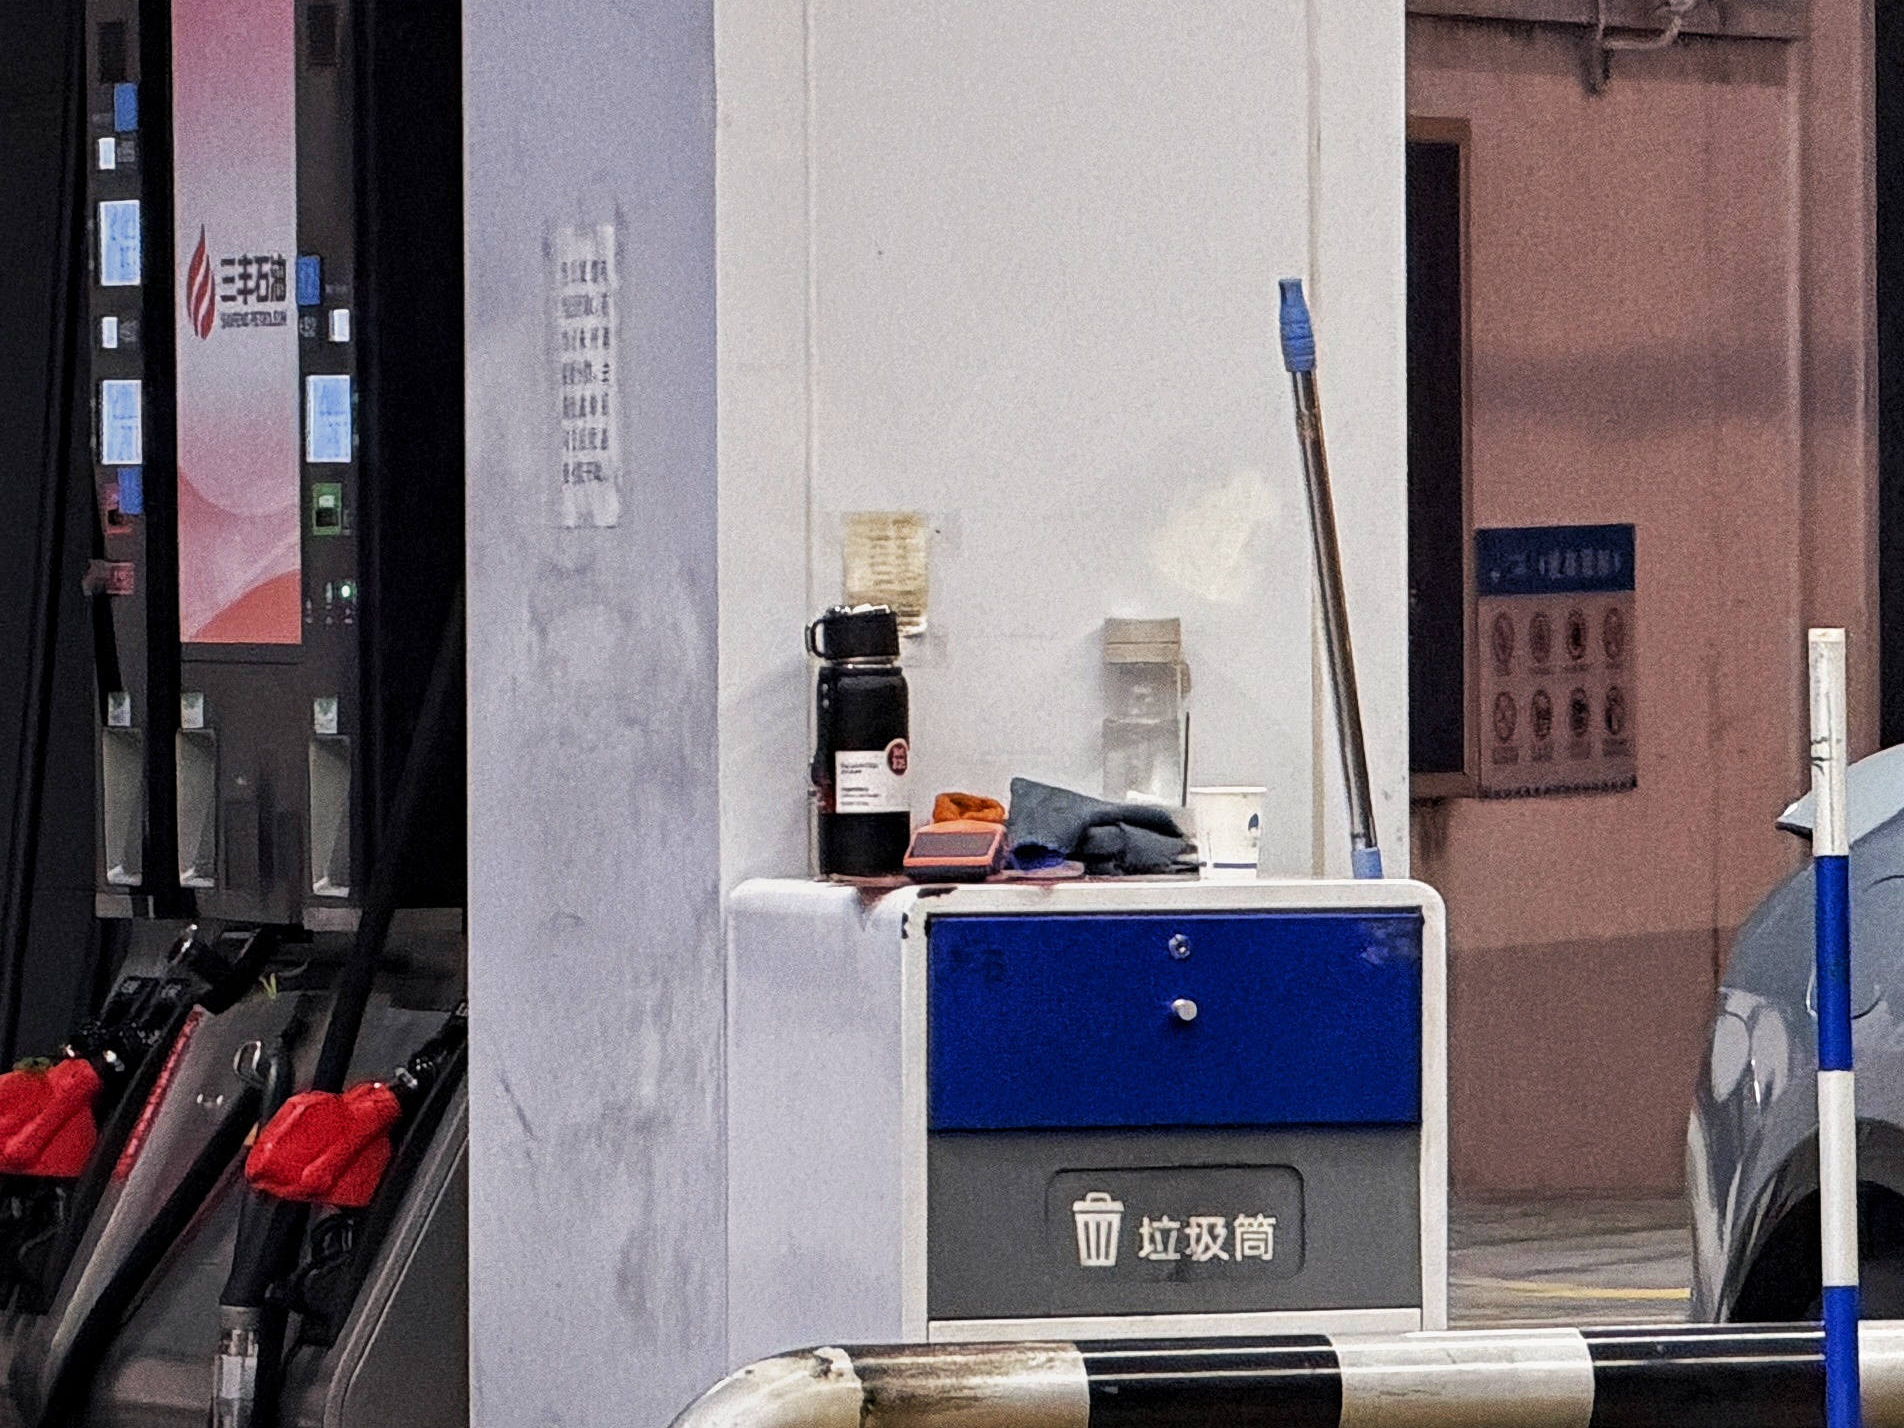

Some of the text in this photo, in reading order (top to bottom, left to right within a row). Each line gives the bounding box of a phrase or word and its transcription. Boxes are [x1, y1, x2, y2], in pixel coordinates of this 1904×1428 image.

[219, 253, 288, 306] 三丰石油
[1137, 1212, 1278, 1263] 垃圾筒
